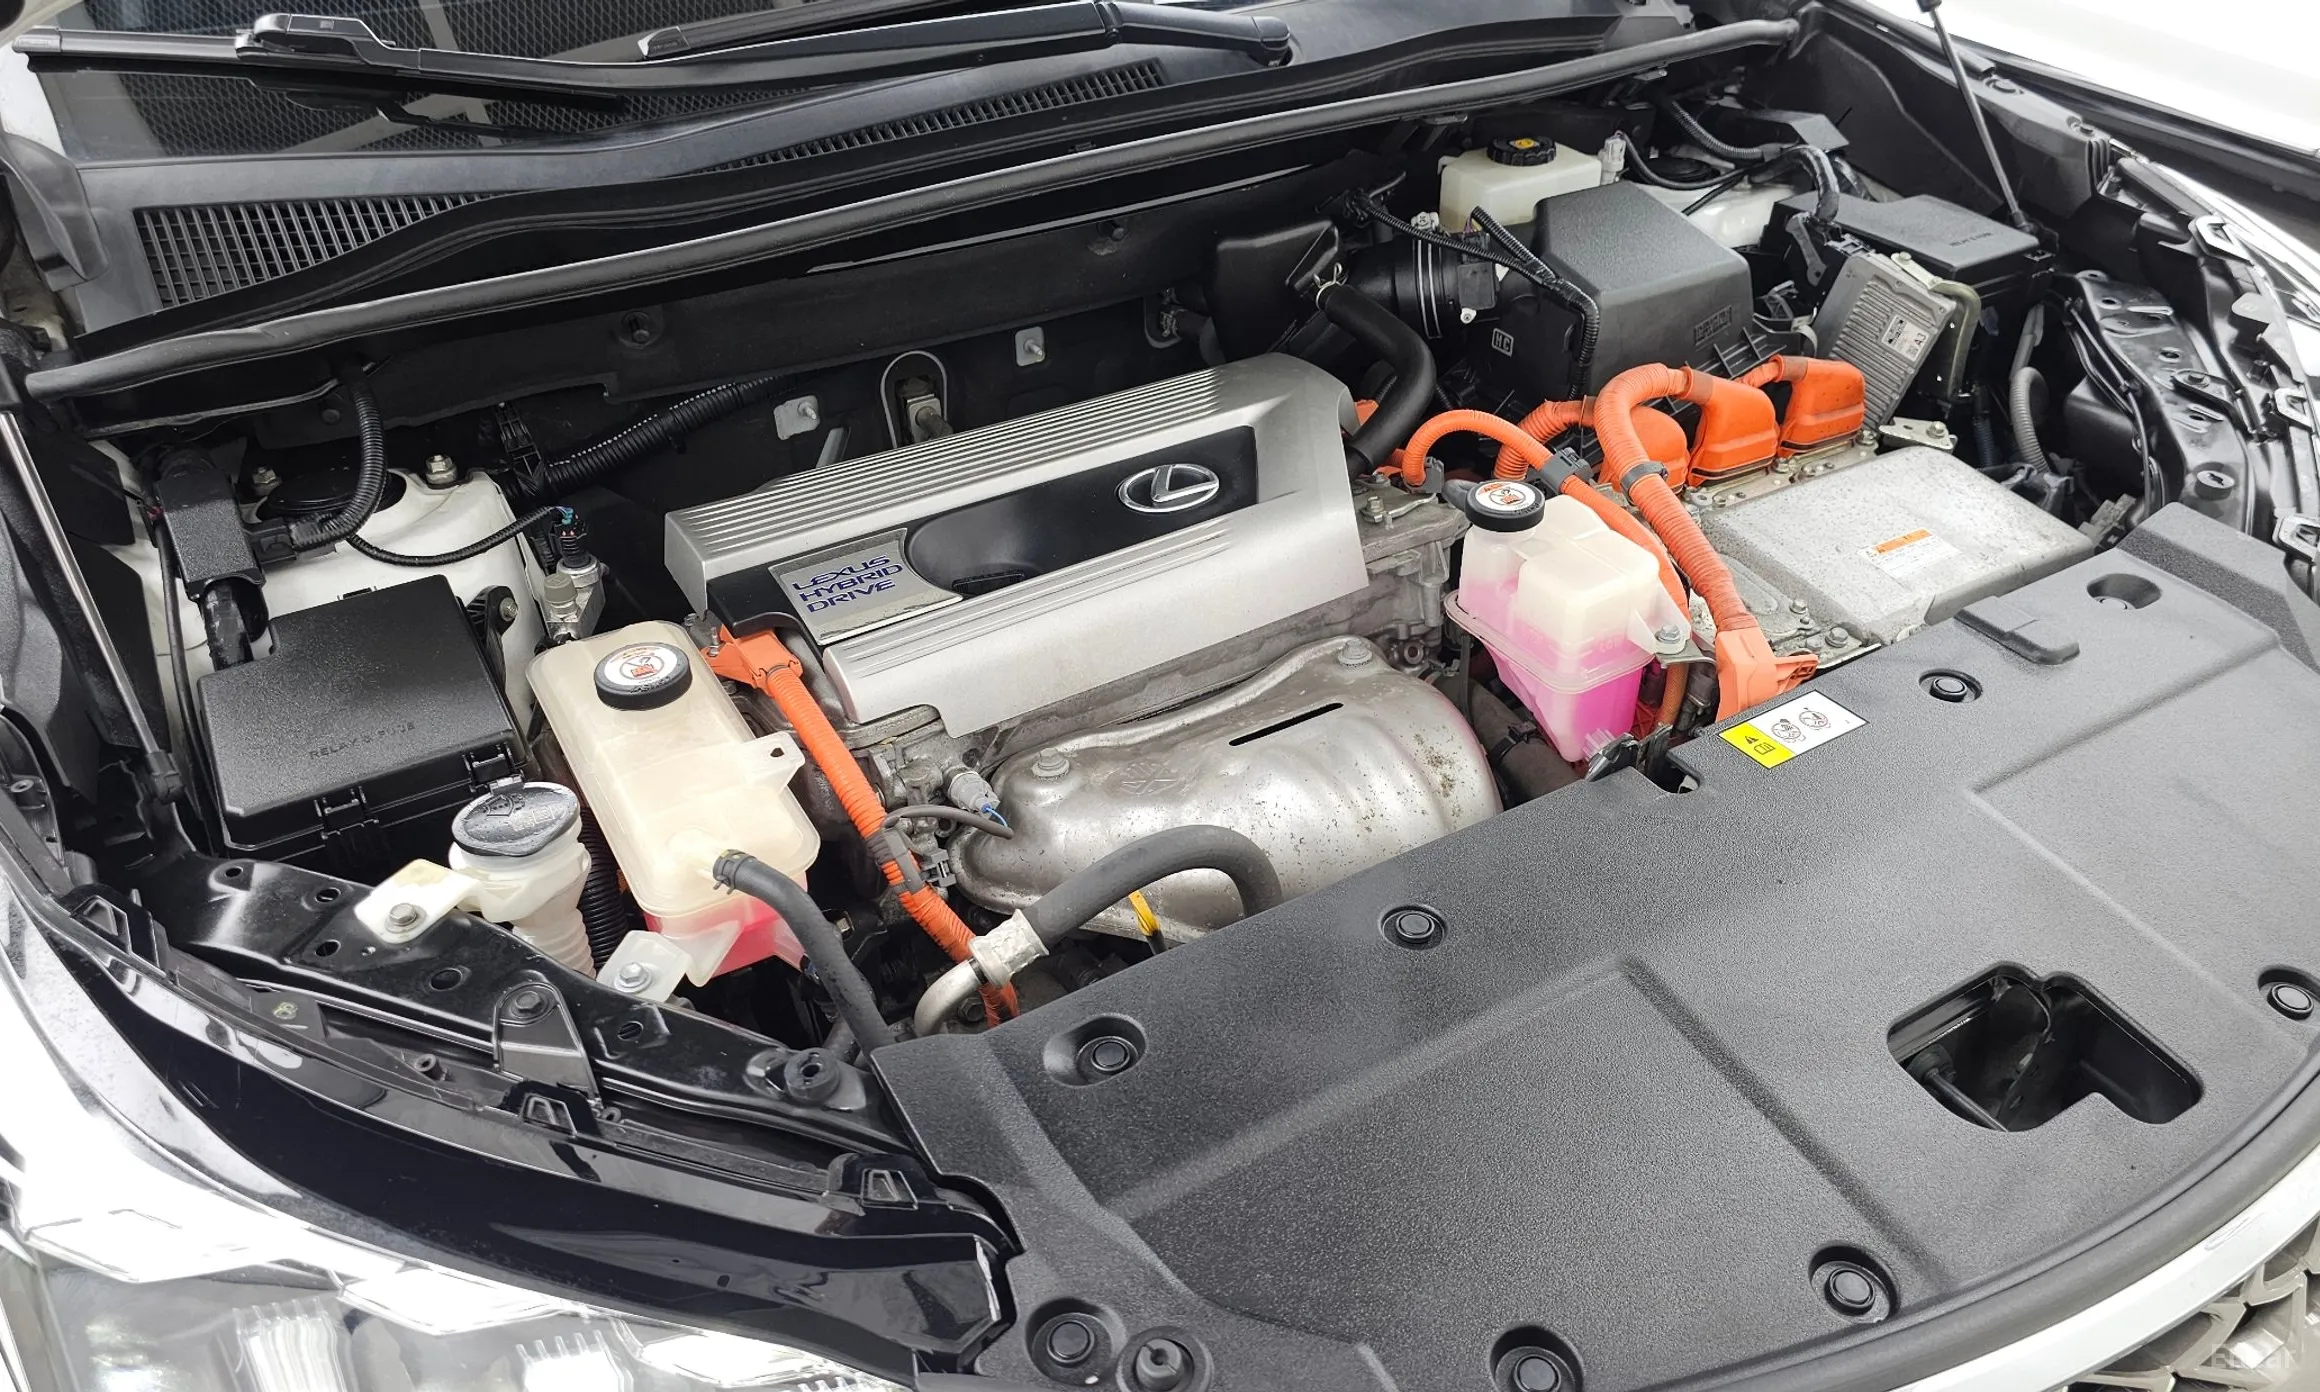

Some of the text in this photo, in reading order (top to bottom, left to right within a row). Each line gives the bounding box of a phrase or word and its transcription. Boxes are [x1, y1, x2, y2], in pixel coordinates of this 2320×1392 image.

[792, 555, 890, 590] LEXUS
[799, 564, 903, 602] HYBRID
[806, 579, 896, 613] DRIVE
[308, 737, 358, 760] RELAY
